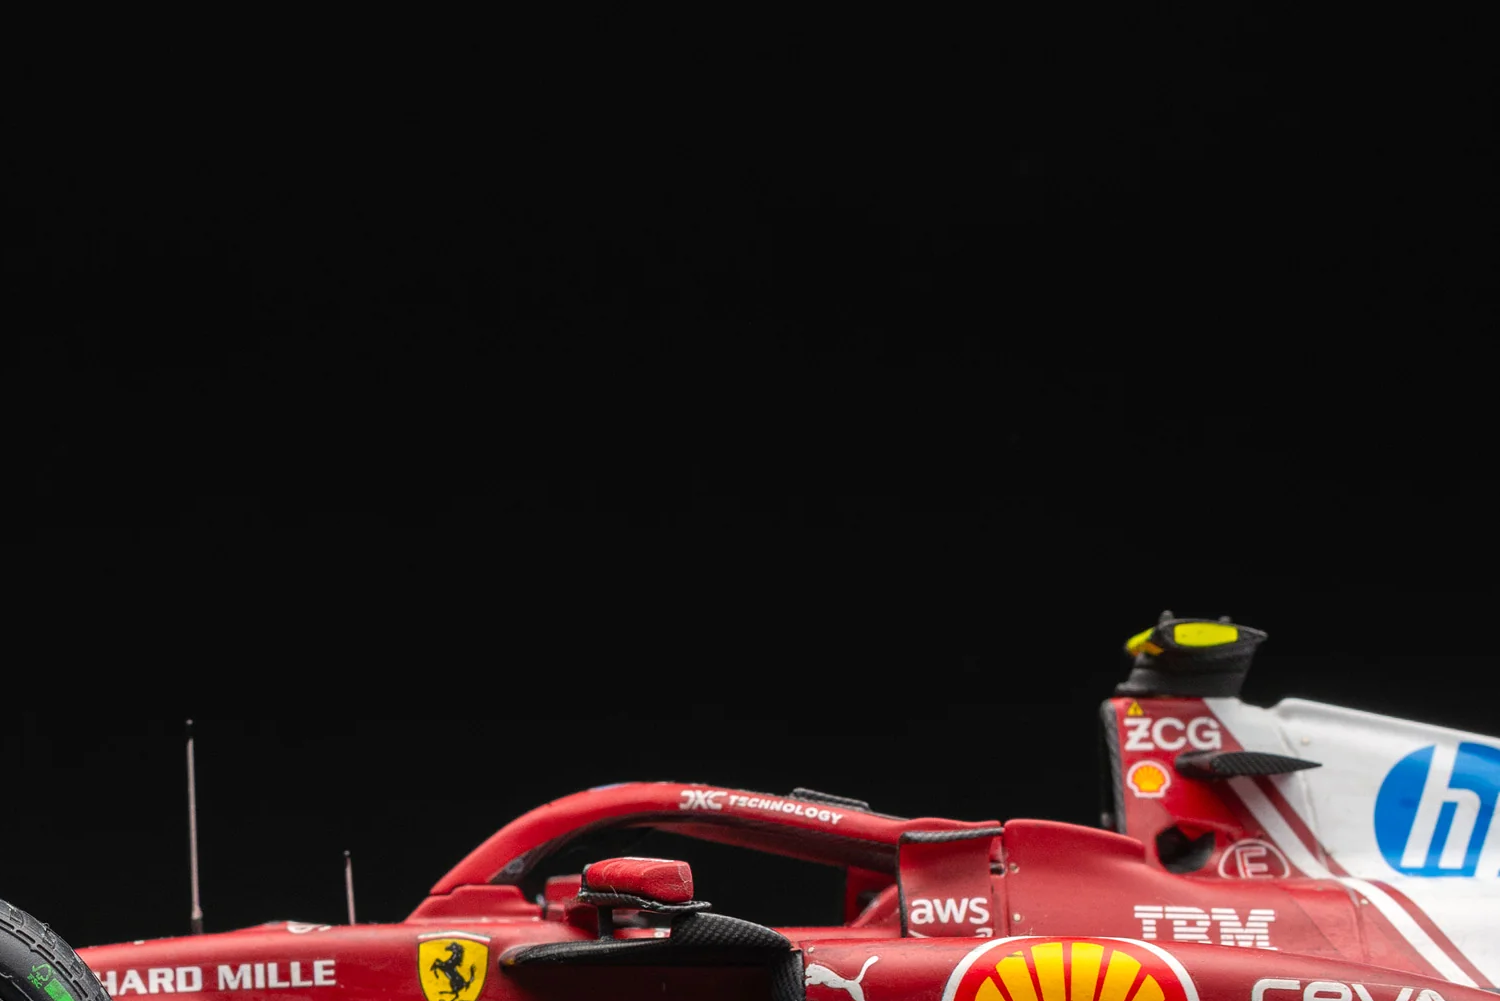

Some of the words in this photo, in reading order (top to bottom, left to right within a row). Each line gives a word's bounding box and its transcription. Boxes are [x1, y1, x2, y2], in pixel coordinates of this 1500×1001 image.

[728, 794, 843, 825] TECHNOLOGY
[910, 896, 990, 925] aws
[217, 959, 337, 991] MILLE
